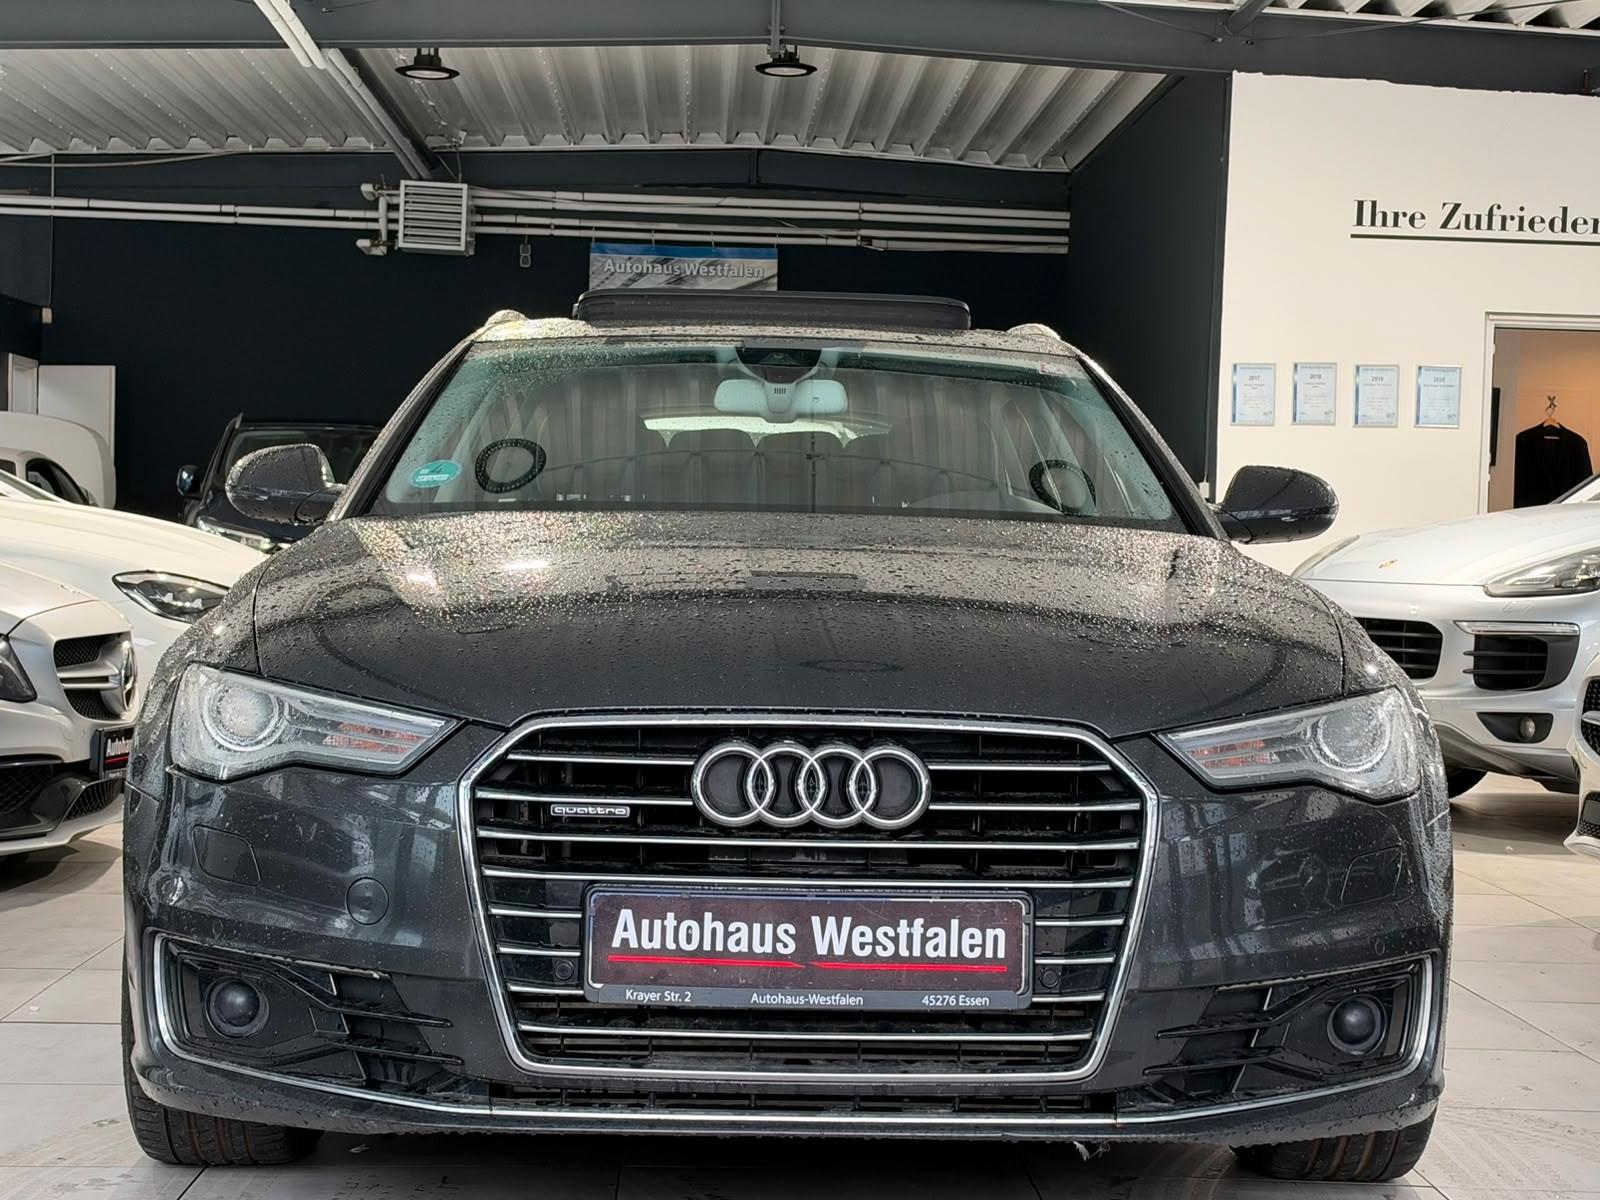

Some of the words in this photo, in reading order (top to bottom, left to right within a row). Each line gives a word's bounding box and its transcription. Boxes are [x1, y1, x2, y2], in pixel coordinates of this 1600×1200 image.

[1353, 199, 1427, 229] Ihre
[604, 258, 681, 276] Autohaus
[683, 262, 765, 279] Westfalen
[554, 806, 626, 816] quattro
[611, 908, 796, 955] Autohaus
[811, 915, 1006, 959] Westfalen
[625, 989, 661, 1002] Krayer
[664, 990, 682, 1002] Str.
[684, 992, 692, 1002] 2
[751, 992, 864, 1006] Autohaus-Westfalen
[921, 995, 956, 1006] 45276
[959, 995, 989, 1006] Essen
